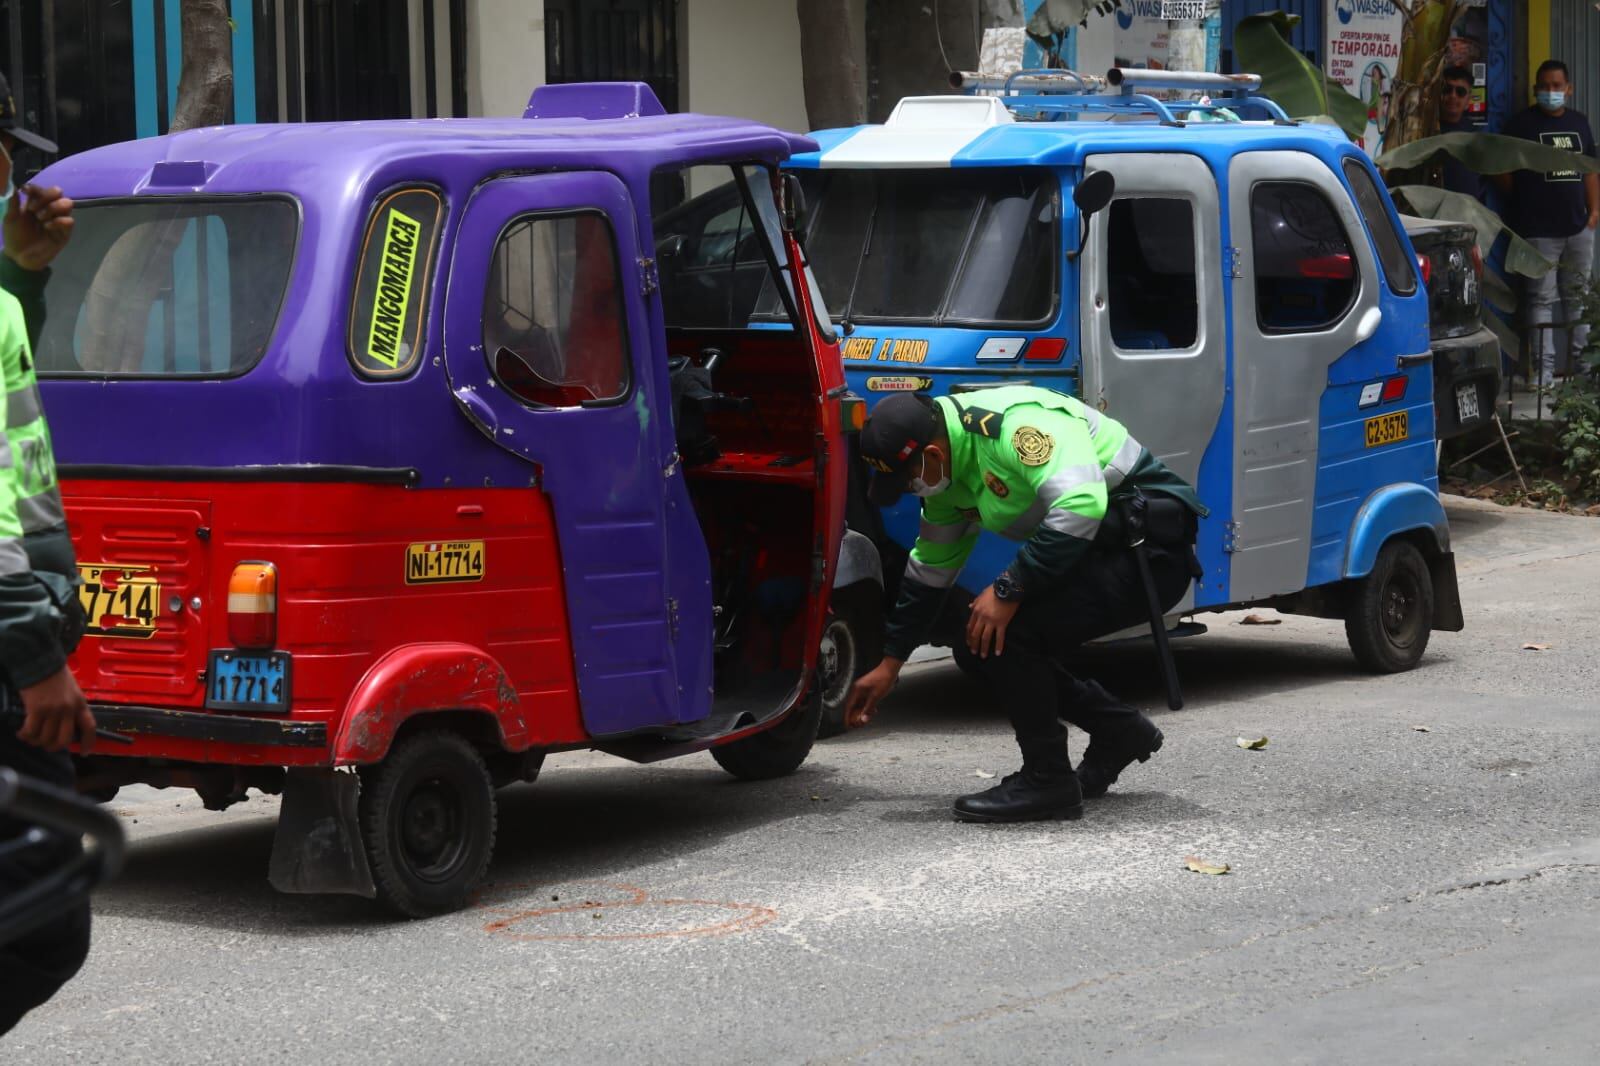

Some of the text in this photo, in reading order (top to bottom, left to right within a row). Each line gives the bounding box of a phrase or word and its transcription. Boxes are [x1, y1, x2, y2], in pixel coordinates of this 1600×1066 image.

[1331, 41, 1398, 57] TEMPORADA
[1340, 31, 1390, 42] OFERTA POR FIN DE
[1340, 60, 1353, 68] TODA
[371, 217, 417, 361] MANGOMARCA
[878, 338, 893, 361] EL
[891, 338, 929, 364] PARAISO
[1367, 413, 1407, 444] C2-3579
[411, 550, 482, 577] NI-17714
[76, 584, 153, 626] 7714
[218, 675, 282, 702] 17714
